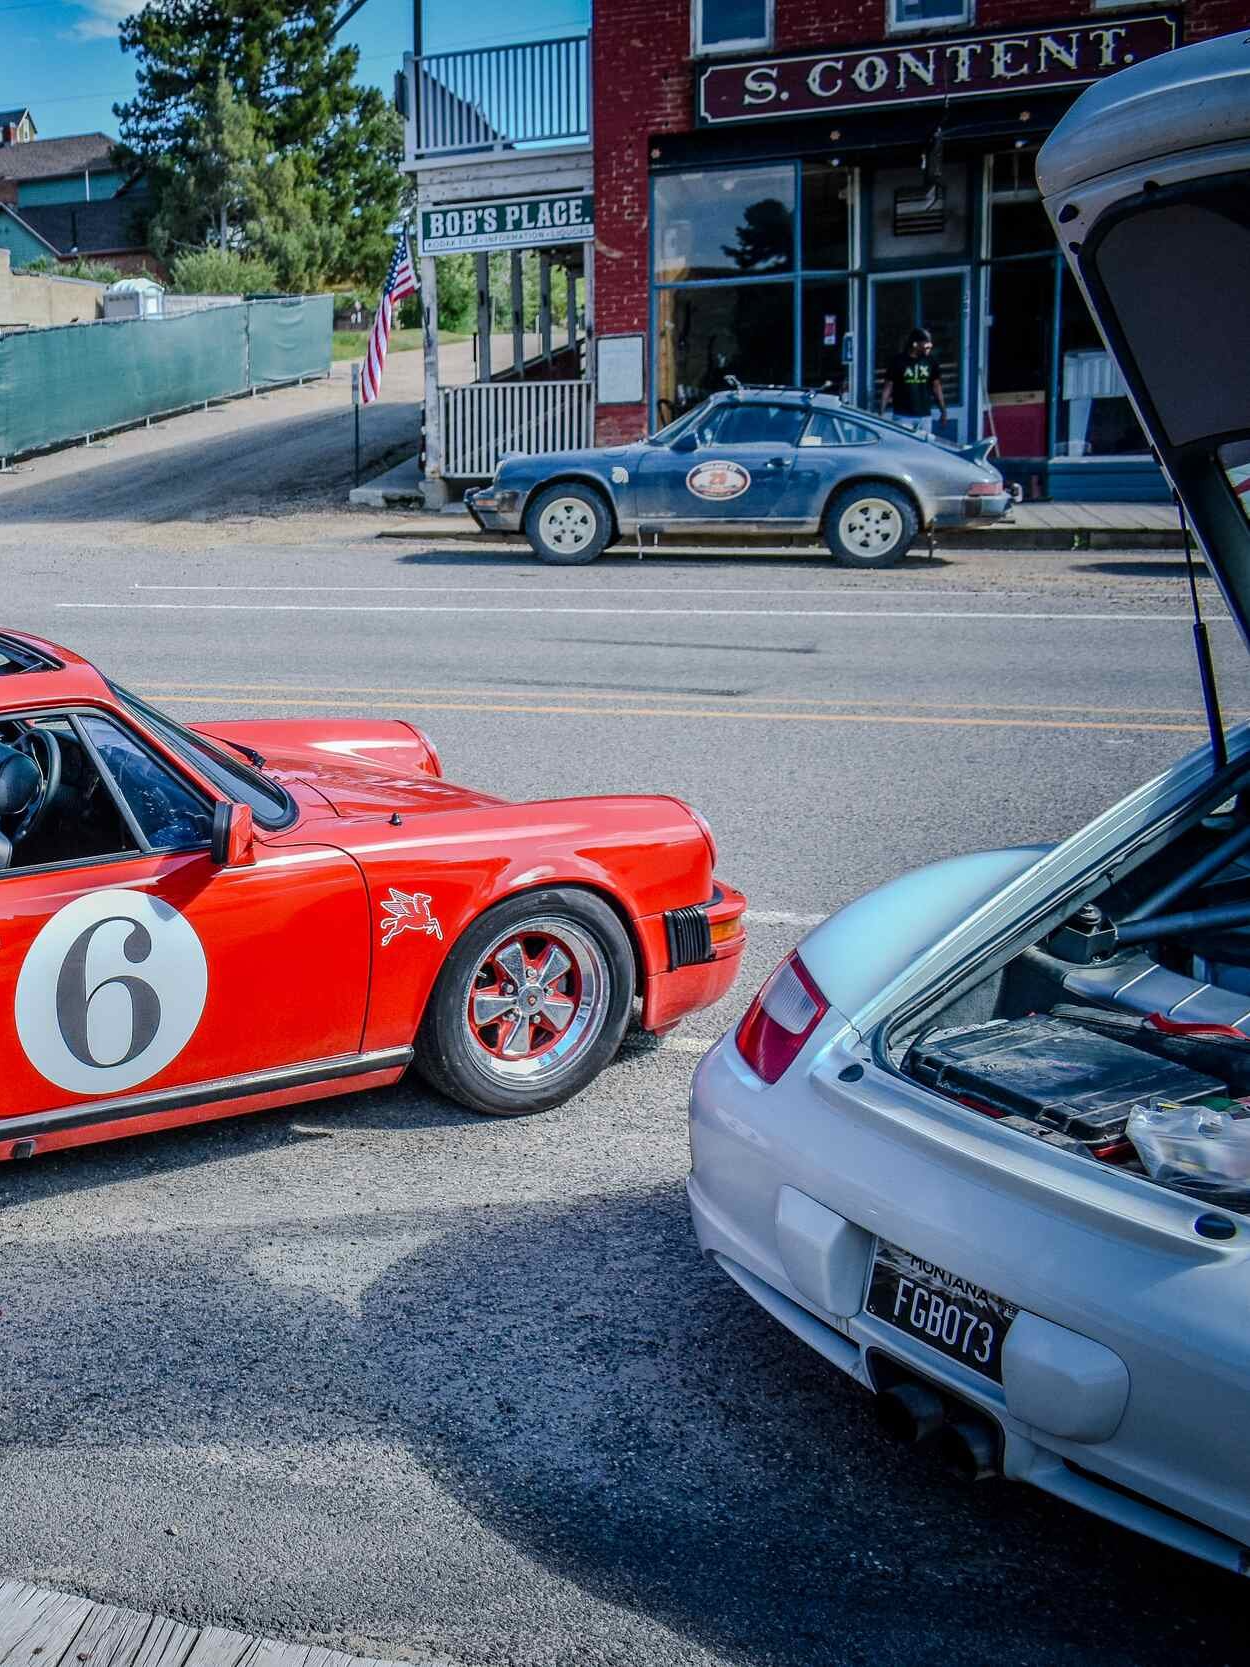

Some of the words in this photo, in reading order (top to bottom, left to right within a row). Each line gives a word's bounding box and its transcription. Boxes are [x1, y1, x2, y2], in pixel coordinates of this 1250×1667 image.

[743, 67, 789, 106] S.
[806, 28, 1134, 98] CONTENT.
[429, 208, 498, 238] BOB'S
[505, 199, 591, 231] PLACE.
[484, 231, 545, 245] INFORMATION
[56, 916, 162, 1068] 6
[909, 1254, 990, 1303] MONTANA
[893, 1277, 994, 1363] FGB073
